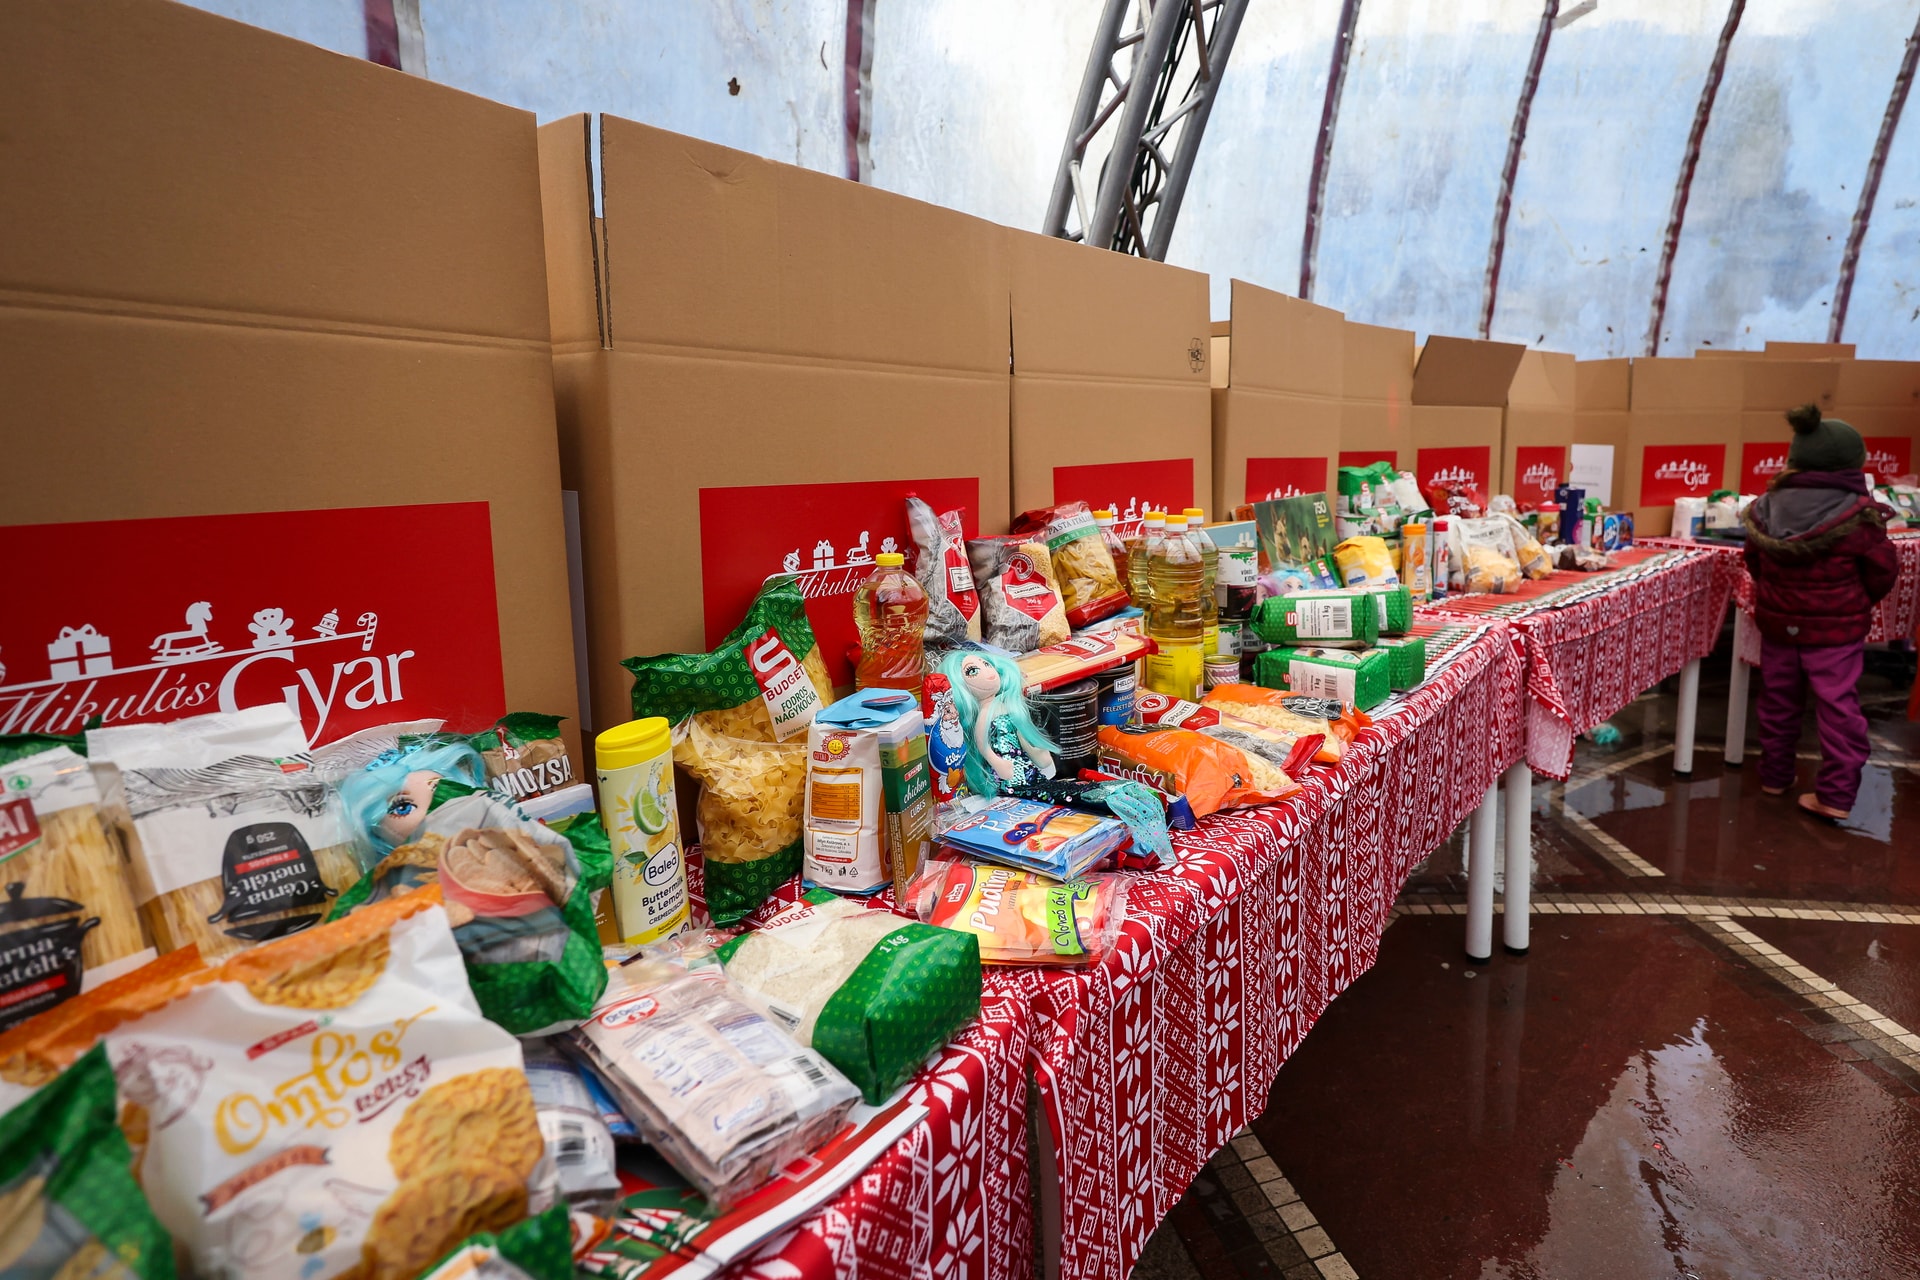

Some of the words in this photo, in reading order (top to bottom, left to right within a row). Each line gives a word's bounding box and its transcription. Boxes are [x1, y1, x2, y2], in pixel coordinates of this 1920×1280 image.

[766, 665, 805, 701] BUDGET
[774, 691, 818, 725] NAGYKOCKA
[781, 685, 808, 712] FODROS
[904, 777, 927, 803] chicken
[910, 799, 926, 817] CUBES
[257, 832, 276, 844] 250
[648, 856, 677, 880] Balea
[642, 875, 683, 907] Buttermilk
[648, 906, 655, 915] &
[658, 888, 683, 911] Lemon
[970, 869, 1017, 932] Puding
[764, 907, 816, 931] BUDGET
[888, 934, 909, 947] kg
